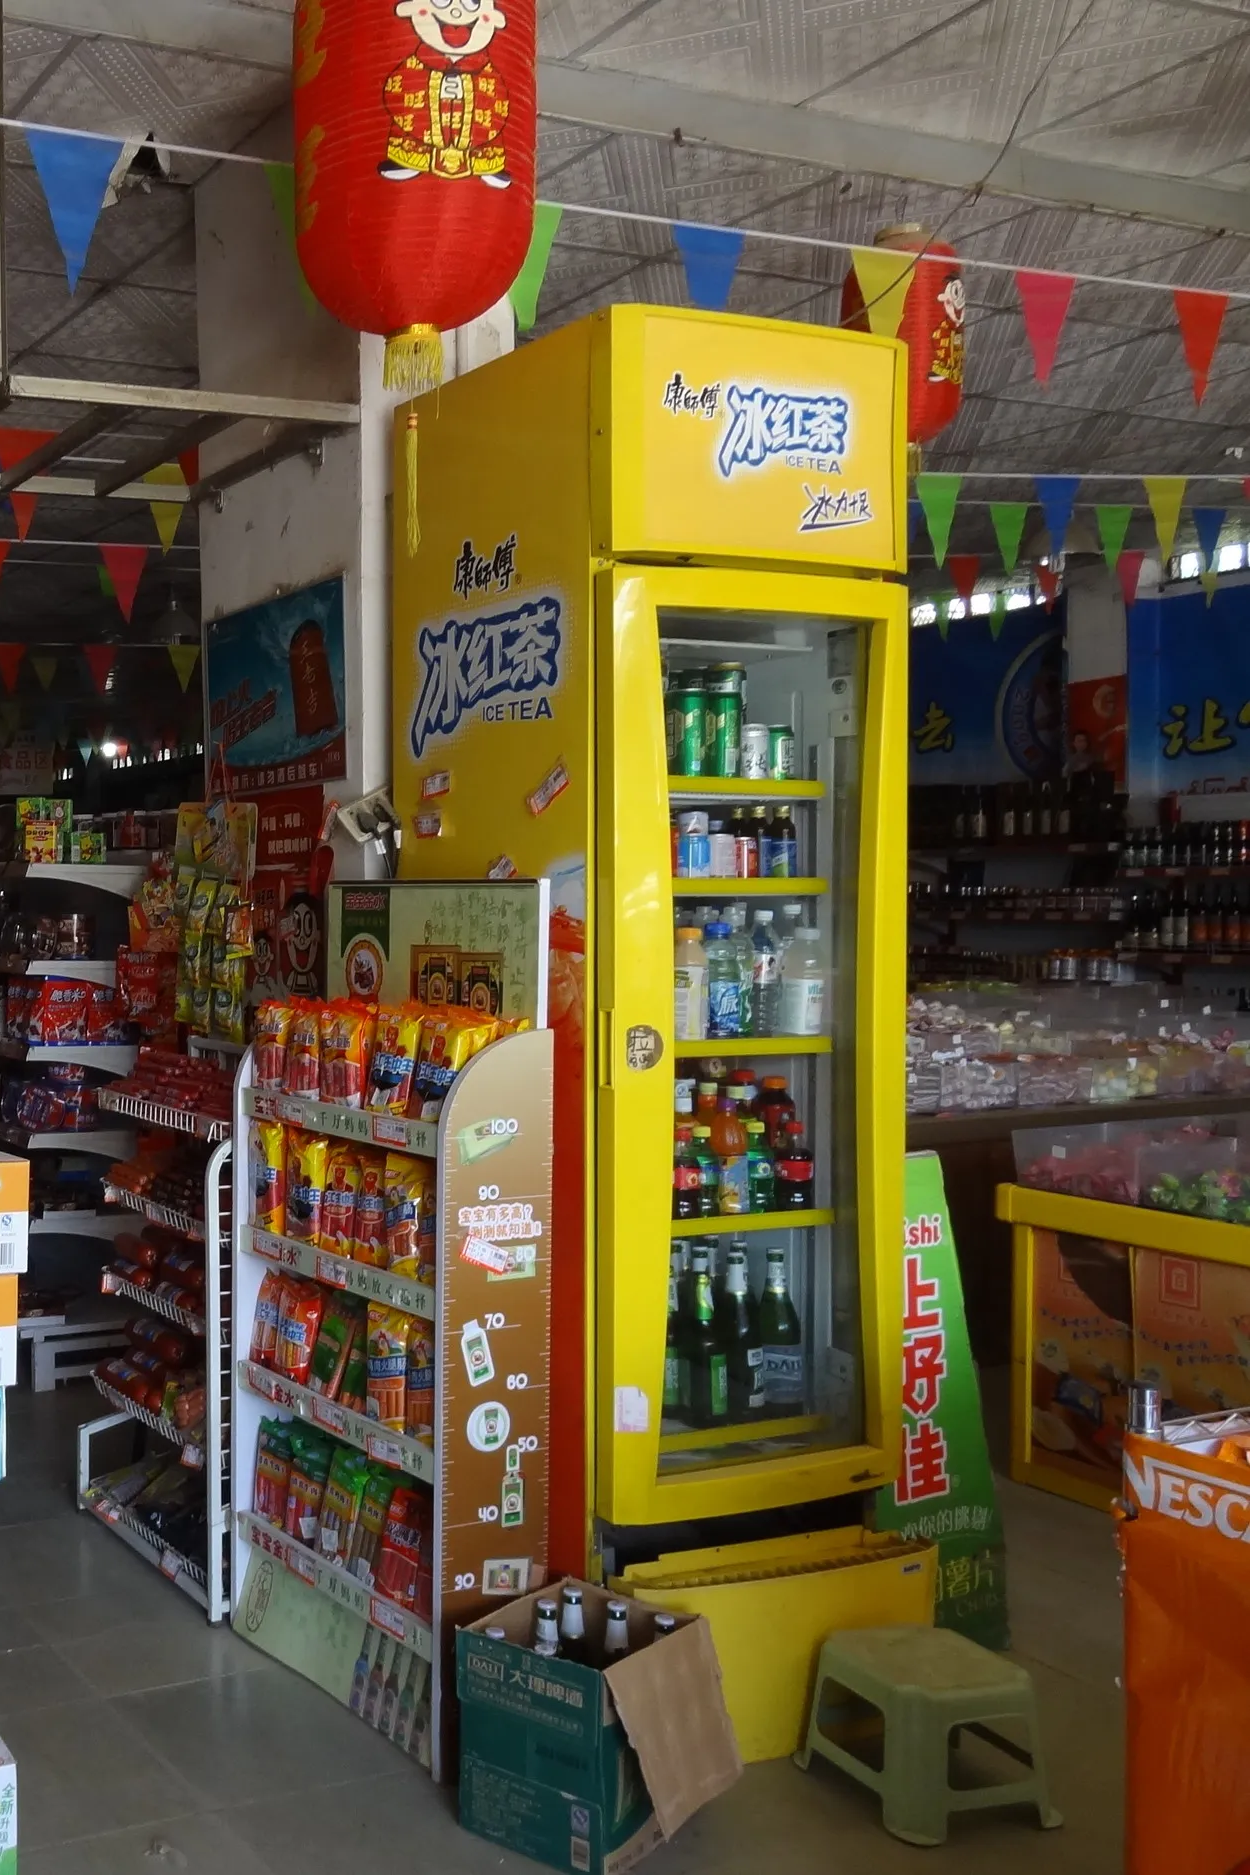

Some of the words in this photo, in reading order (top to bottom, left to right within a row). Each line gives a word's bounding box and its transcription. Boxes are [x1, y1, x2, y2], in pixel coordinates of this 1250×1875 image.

[719, 385, 848, 478] 冰红茶
[785, 455, 803, 468] ICE
[807, 457, 842, 475] TEA
[412, 596, 561, 758] 冰红茶
[482, 704, 504, 722] ICE
[510, 696, 552, 720] TEA
[912, 702, 954, 752] 去
[1162, 698, 1236, 758] 让
[490, 1118, 518, 1135] 100
[478, 1185, 499, 1200] 90
[904, 1214, 941, 1246] ishi
[485, 1313, 505, 1329] 70
[506, 1374, 528, 1390] 60
[517, 1436, 538, 1451] 50
[1123, 1449, 1250, 1545] NESC
[478, 1505, 498, 1522] 40
[454, 1573, 475, 1590] 30
